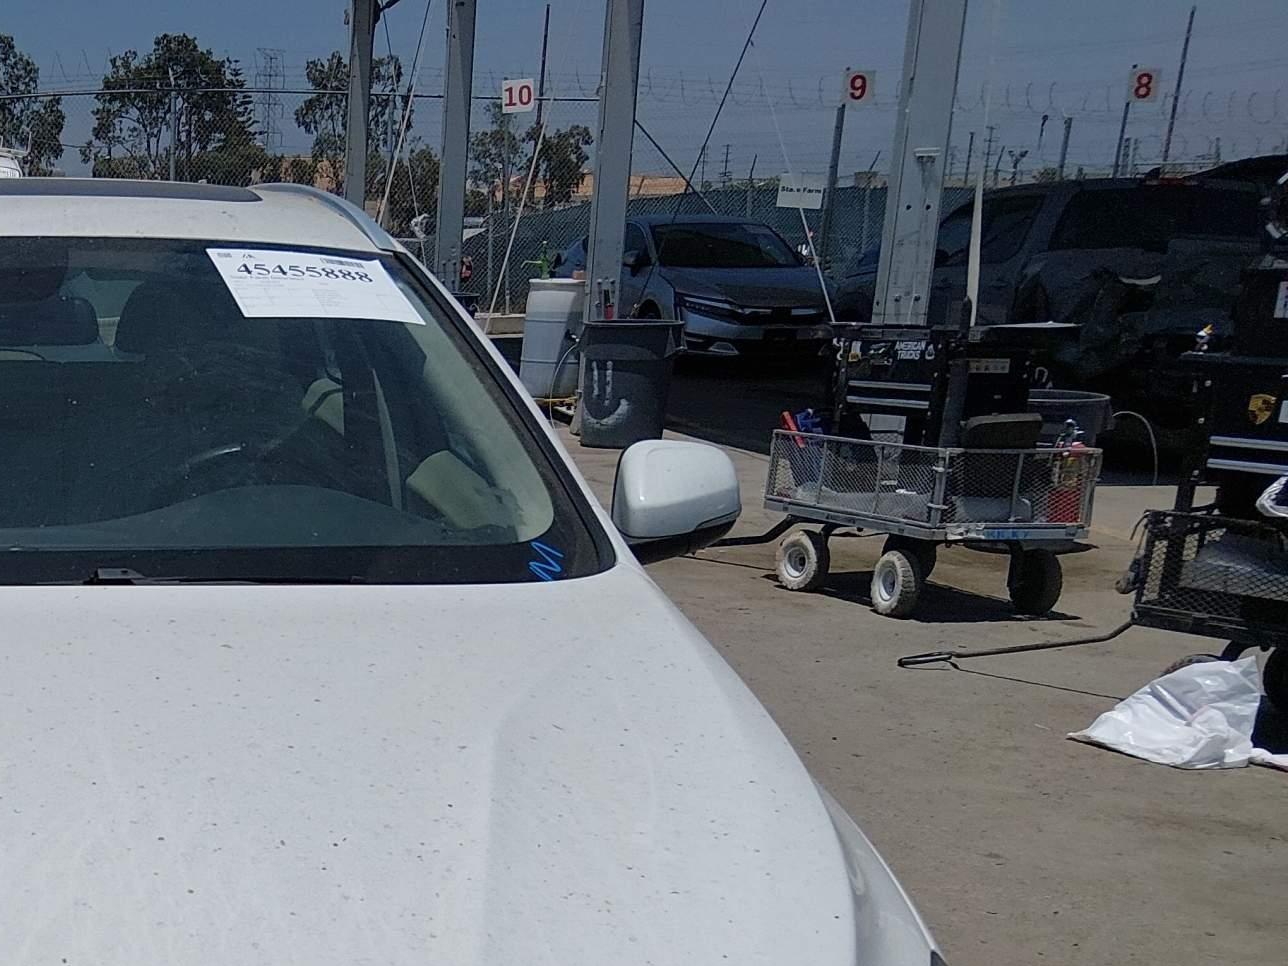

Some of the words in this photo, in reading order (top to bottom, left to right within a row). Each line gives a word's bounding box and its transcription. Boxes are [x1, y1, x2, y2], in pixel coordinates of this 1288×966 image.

[503, 84, 532, 108] 10
[849, 74, 868, 100] 9
[1134, 73, 1153, 99] 8
[236, 262, 374, 283] 45455888
[894, 340, 927, 351] AMERICAN
[896, 351, 921, 361] TRUCKS
